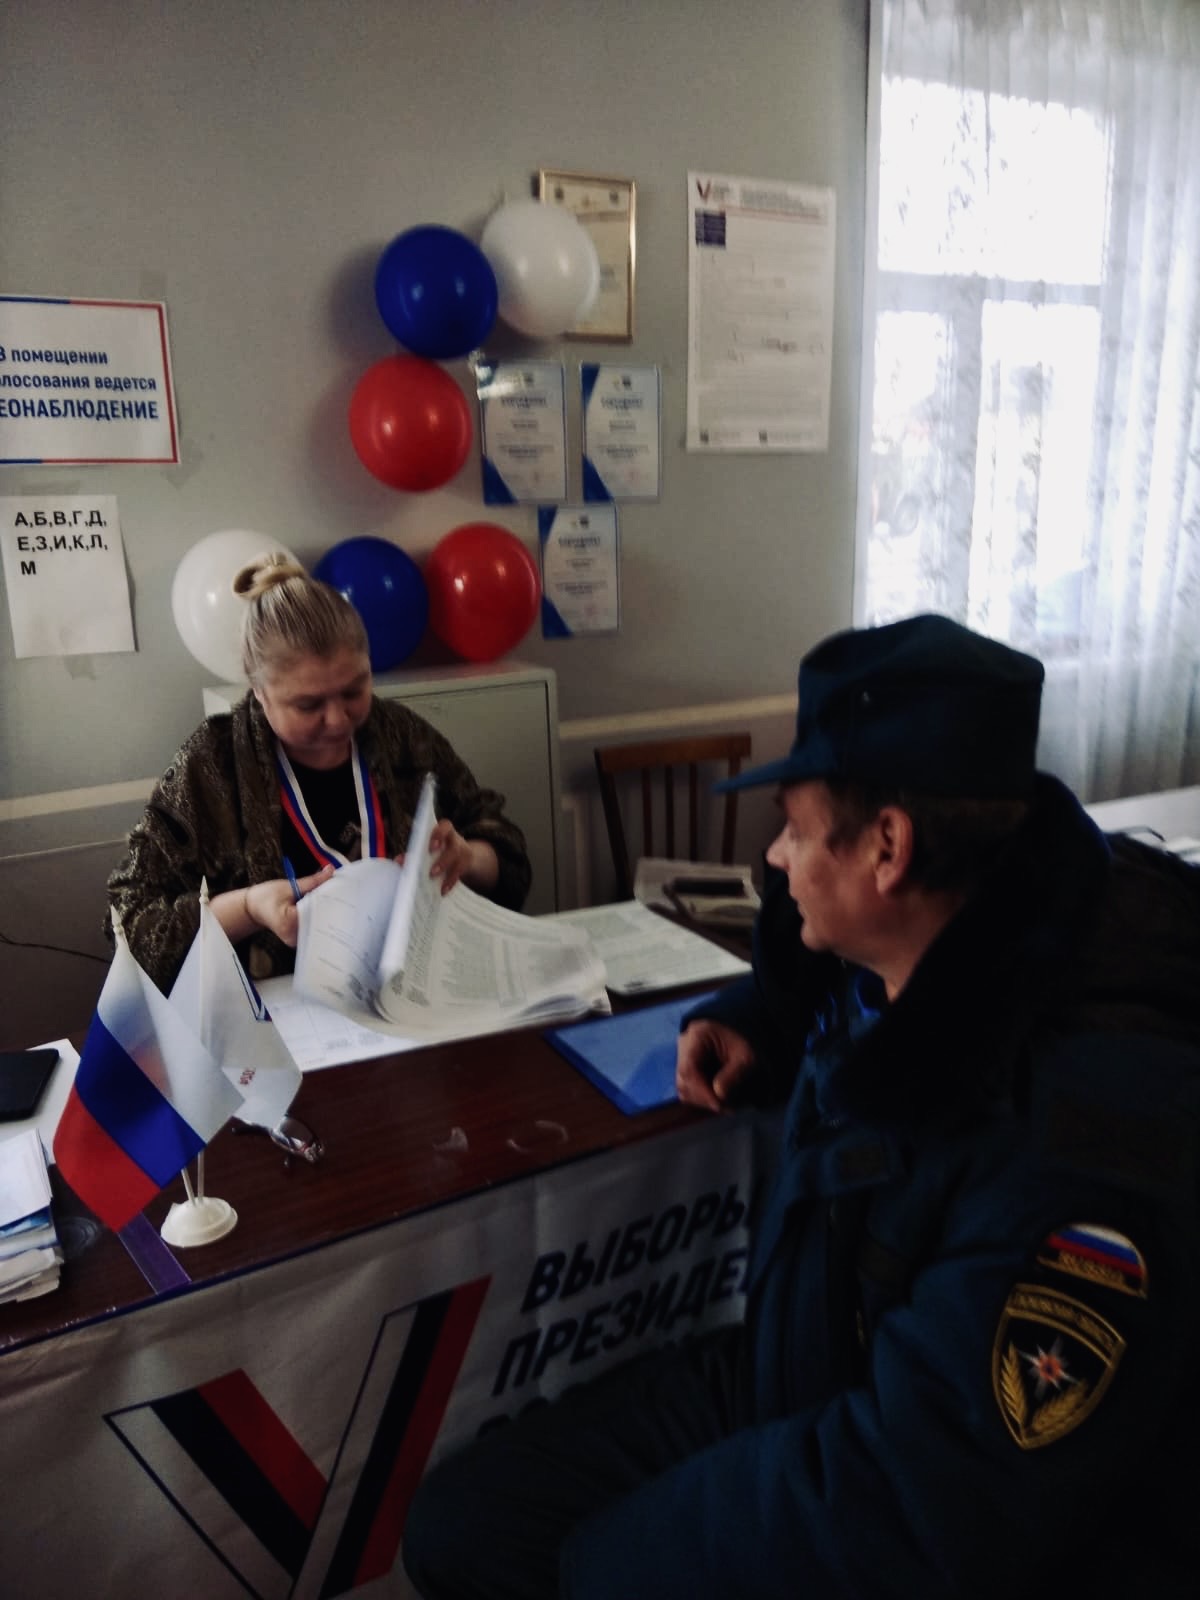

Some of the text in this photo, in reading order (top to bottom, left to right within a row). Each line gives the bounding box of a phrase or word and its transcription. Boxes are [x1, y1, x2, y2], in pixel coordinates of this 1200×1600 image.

[11, 349, 108, 366] помещении
[95, 376, 157, 394] ведется
[20, 560, 36, 576] М
[492, 1250, 750, 1395] ПРЕЗИДЕ
